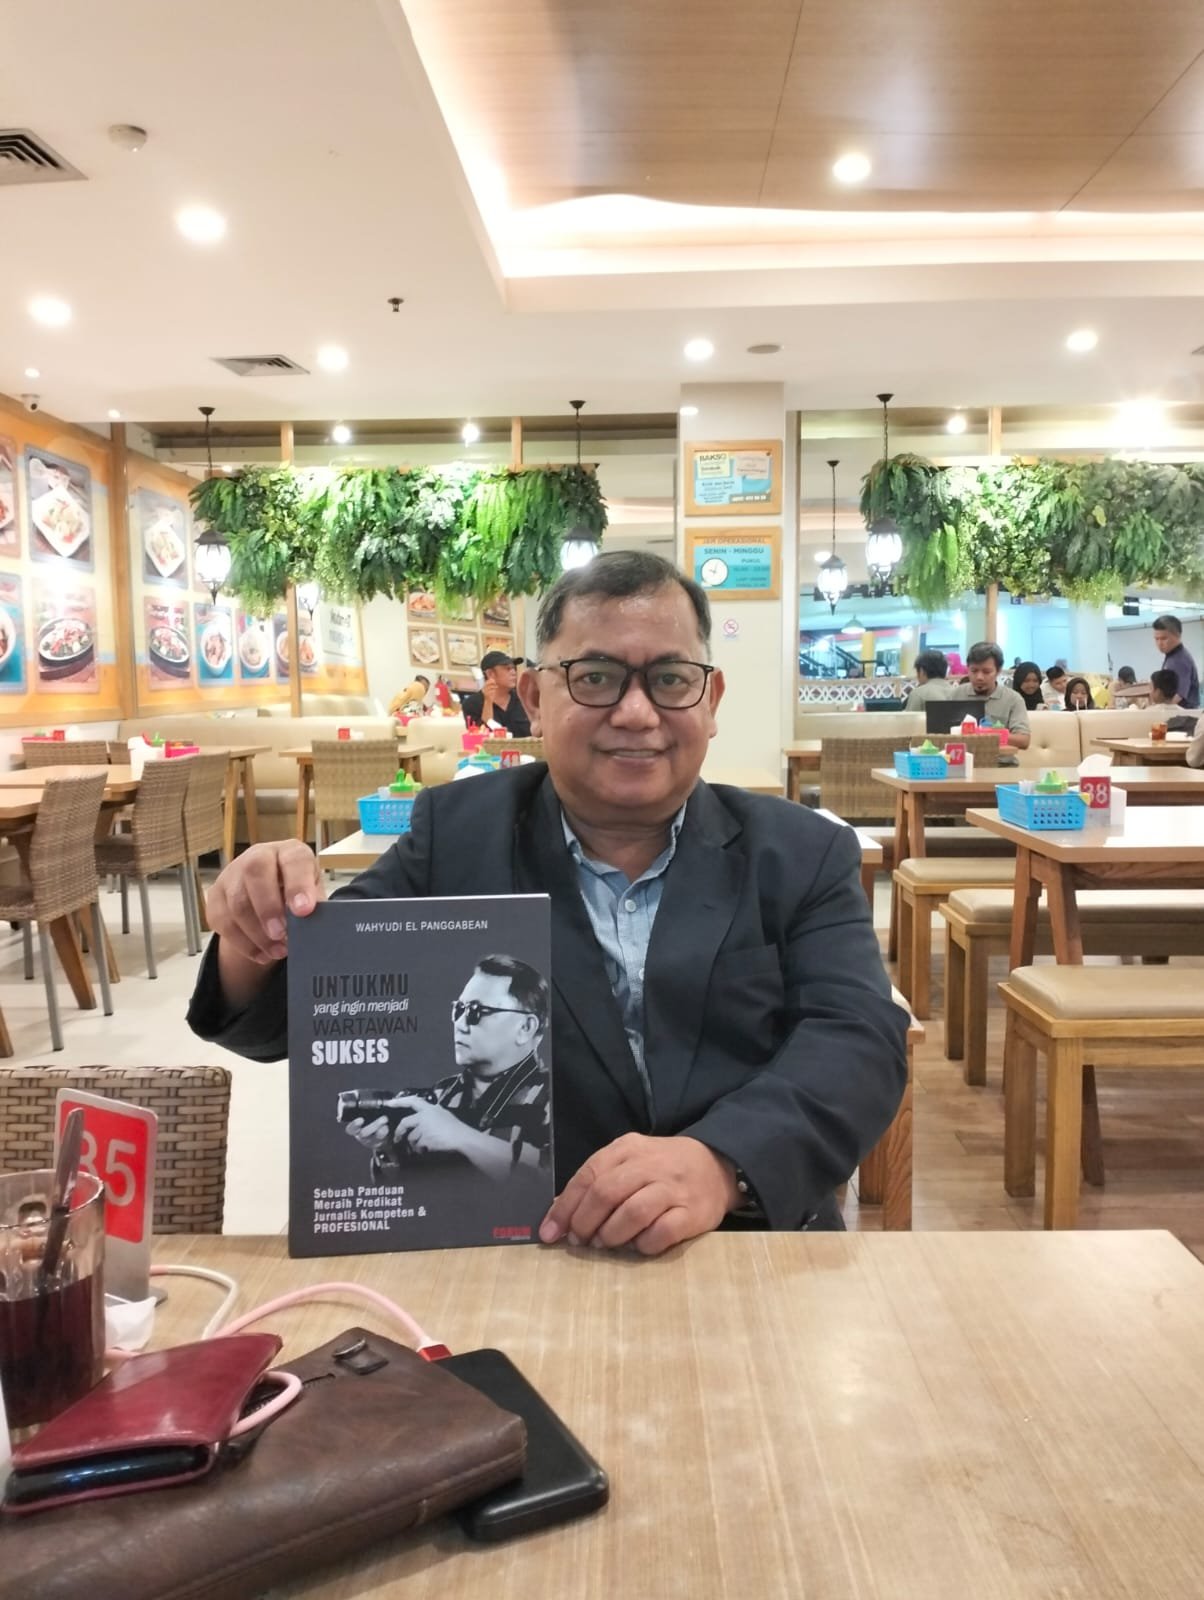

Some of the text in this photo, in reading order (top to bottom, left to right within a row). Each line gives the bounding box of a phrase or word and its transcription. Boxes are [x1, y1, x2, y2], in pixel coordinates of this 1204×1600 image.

[1083, 783, 1107, 804] 38
[355, 920, 488, 932] WAHYUDI EL PANGGABEAN
[312, 973, 408, 998] UNTUKMU
[313, 998, 409, 1016] yang ingin menjadi
[313, 1016, 418, 1036] WARTAWAN
[312, 1038, 390, 1066] SUKSES
[313, 1185, 404, 1199] Sebuah Panduan
[313, 1196, 402, 1210] Meraih Predikat
[313, 1206, 426, 1222] Jurnalis Kompeten &
[313, 1220, 390, 1233] PROFESIONAL
